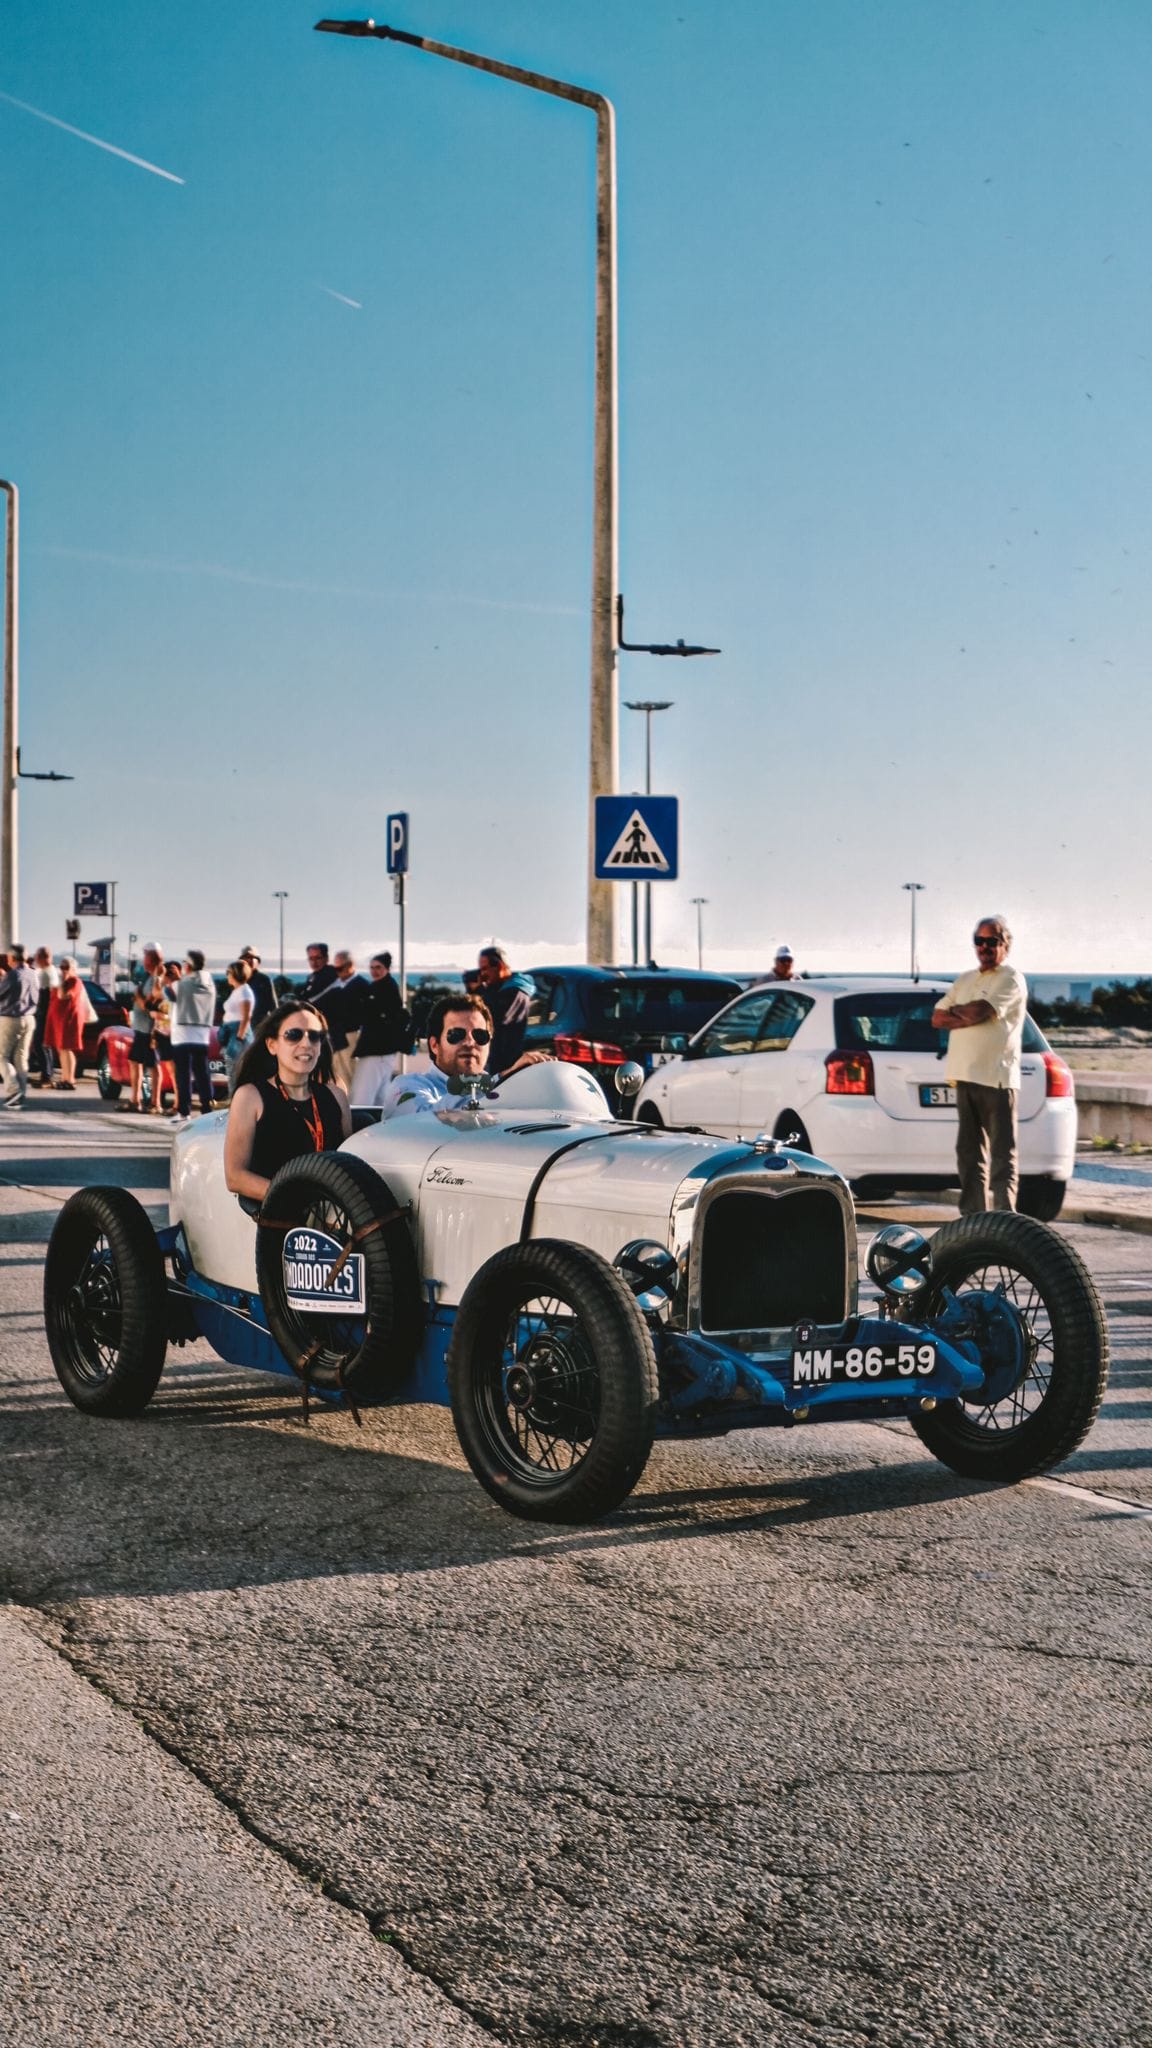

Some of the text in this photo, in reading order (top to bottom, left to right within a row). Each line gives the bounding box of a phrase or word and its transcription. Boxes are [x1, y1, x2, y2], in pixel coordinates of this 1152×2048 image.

[391, 818, 404, 868] P
[77, 886, 92, 904] P
[294, 1234, 318, 1251] 2022
[793, 1344, 936, 1382] MM-86-59
